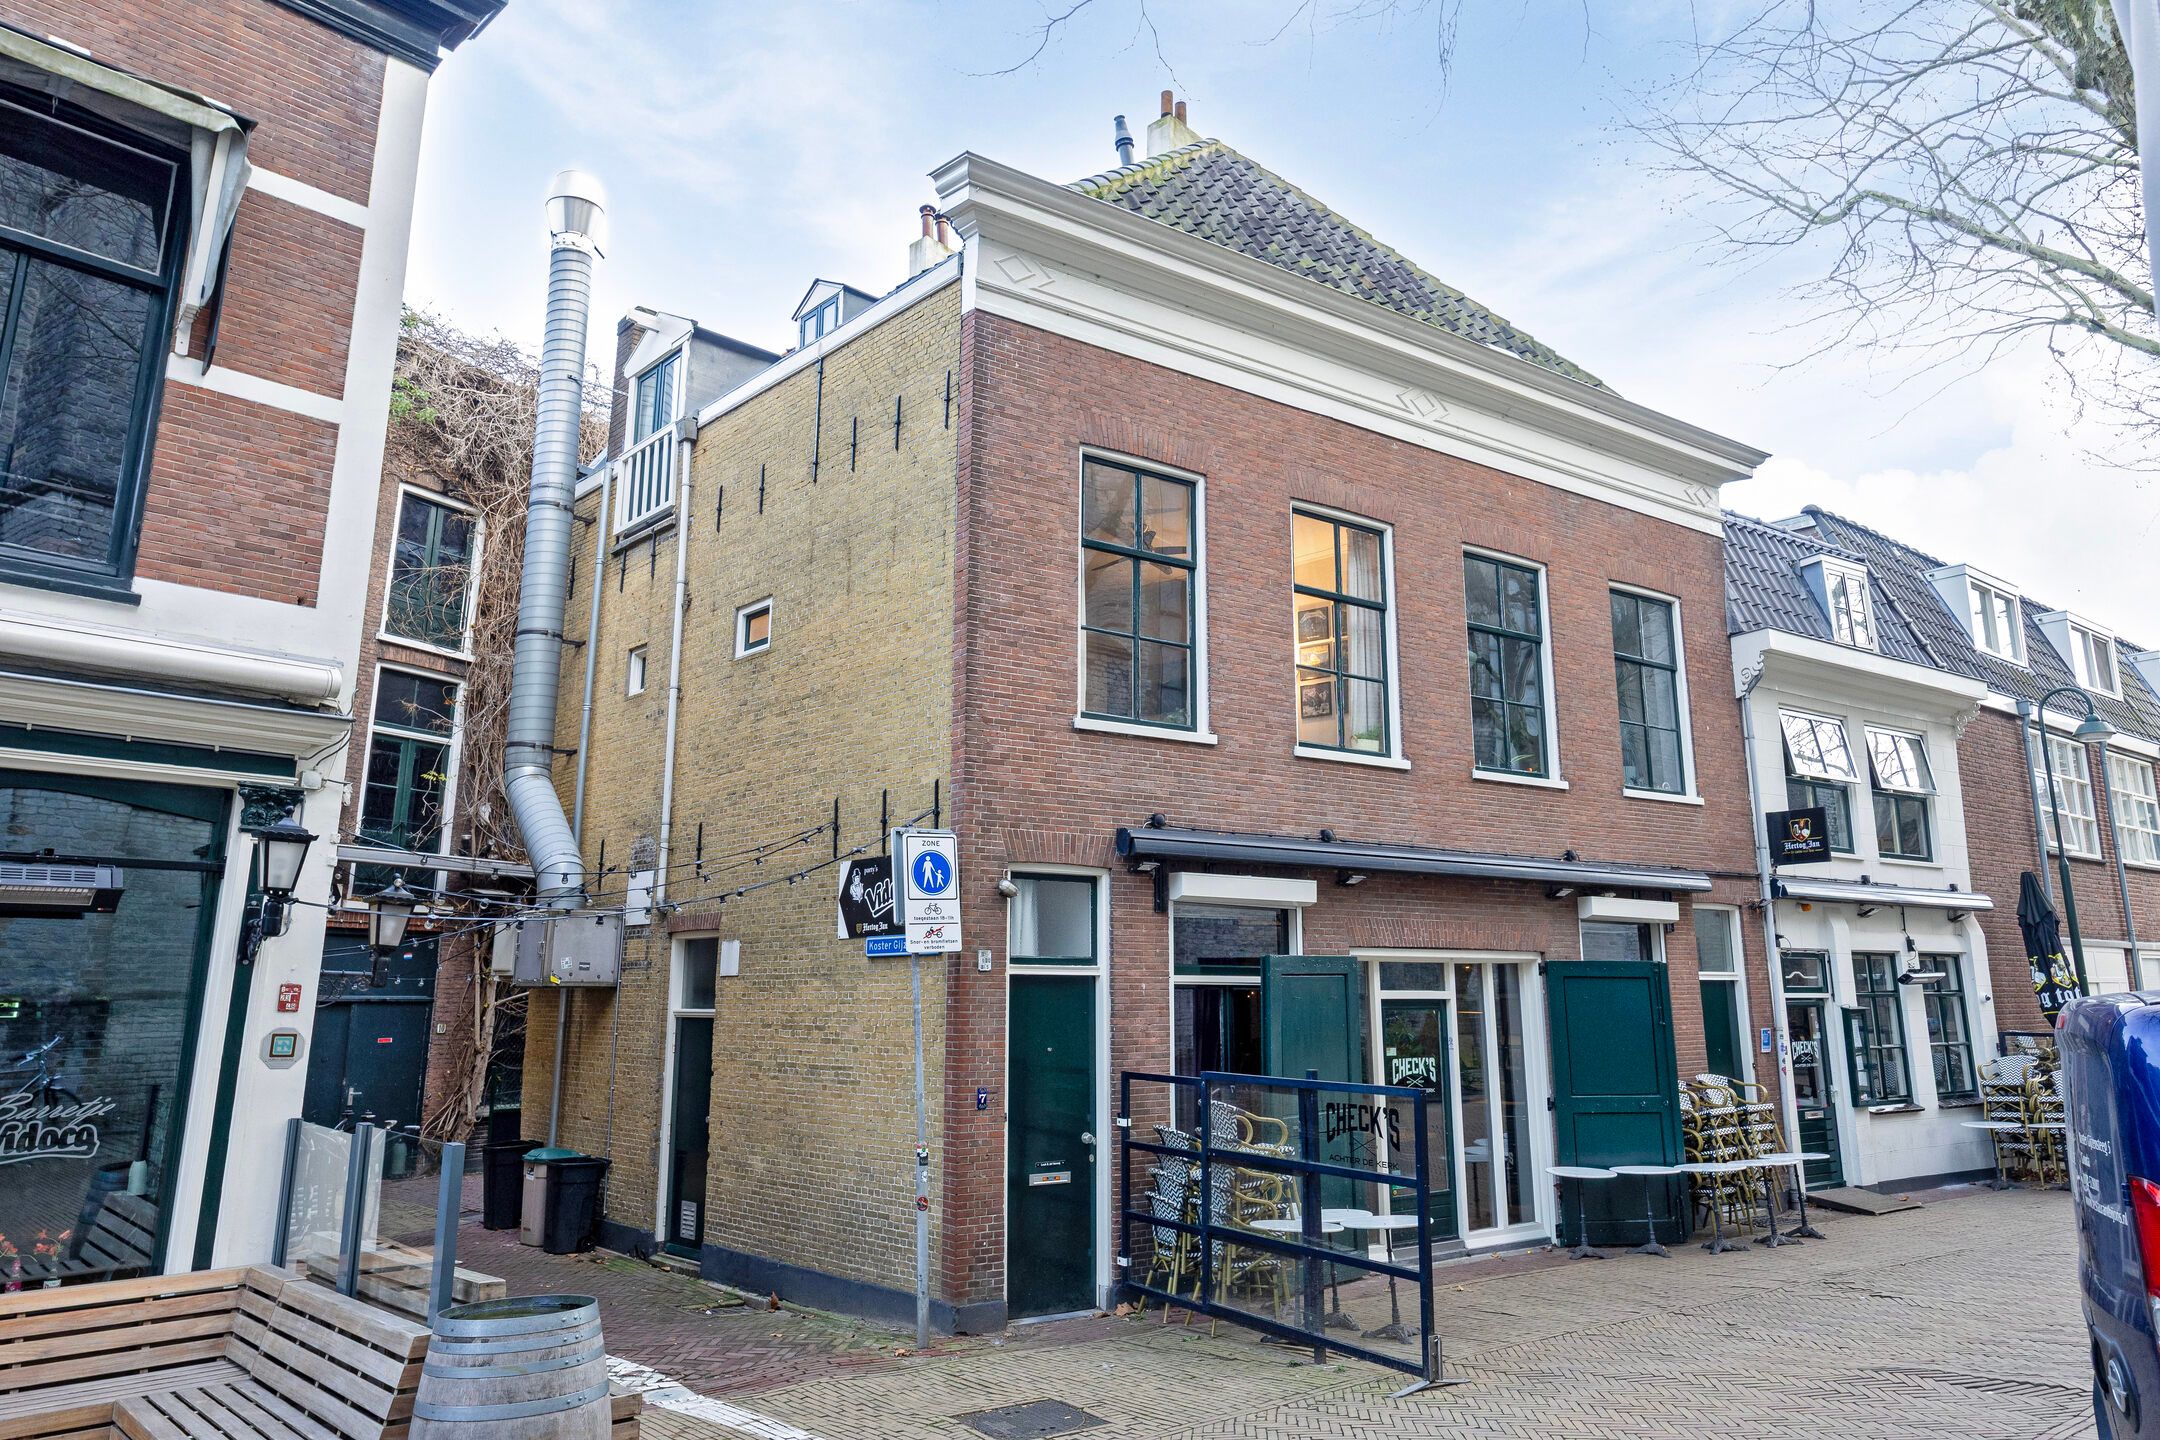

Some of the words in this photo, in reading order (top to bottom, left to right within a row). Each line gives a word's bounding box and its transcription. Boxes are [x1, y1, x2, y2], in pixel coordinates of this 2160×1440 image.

[1784, 842, 1807, 851] Hertog
[864, 878, 894, 918] Vid
[868, 941, 892, 951] Koster
[1792, 1041, 1819, 1061] CHECK'S
[1392, 1057, 1437, 1085] CHECK'S
[0, 1093, 116, 1127] Barretje
[979, 1093, 987, 1104] 7
[1325, 1102, 1400, 1152] CHECK'S
[0, 1120, 100, 1164] idocq
[1329, 1154, 1361, 1165] ACHTER
[1363, 1158, 1374, 1167] DE
[1376, 1159, 1399, 1170] KERK
